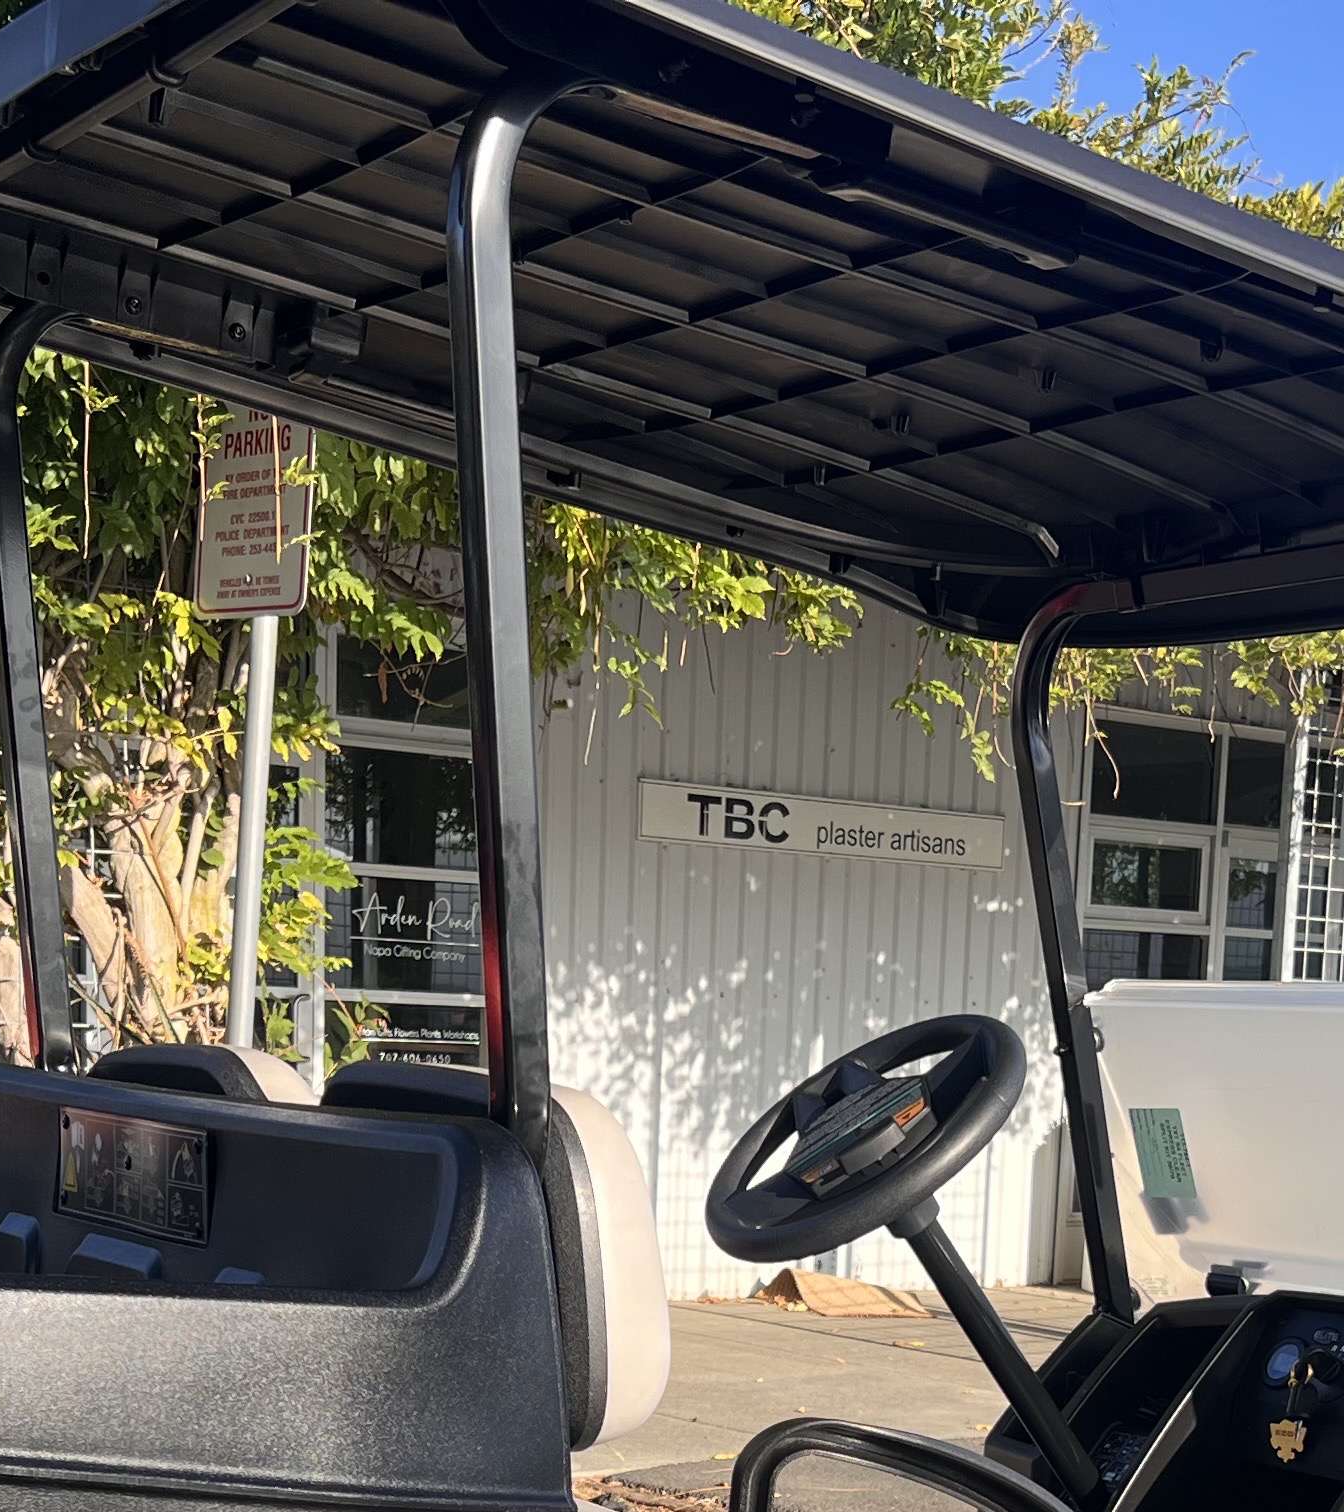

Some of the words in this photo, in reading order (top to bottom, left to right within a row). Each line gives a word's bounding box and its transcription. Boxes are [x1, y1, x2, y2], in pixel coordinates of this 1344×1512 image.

[224, 424, 291, 460] PARKING
[236, 470, 260, 483] ORDER
[262, 468, 271, 480] OF
[240, 484, 287, 499] DEPARTMET
[230, 513, 245, 525] CVC
[215, 530, 240, 542] POLICE
[243, 525, 290, 540] DEPARTMNT
[687, 793, 790, 844] TBC
[816, 821, 885, 850] plaster
[890, 828, 966, 857] artisans
[351, 892, 423, 935] Arden
[426, 897, 480, 941] Road
[364, 943, 392, 957] Napa
[394, 944, 421, 960] Gifting
[423, 946, 466, 963] Company
[394, 1027, 419, 1038] Flowers
[420, 1028, 441, 1039] Plants
[442, 1030, 479, 1040] Workshops
